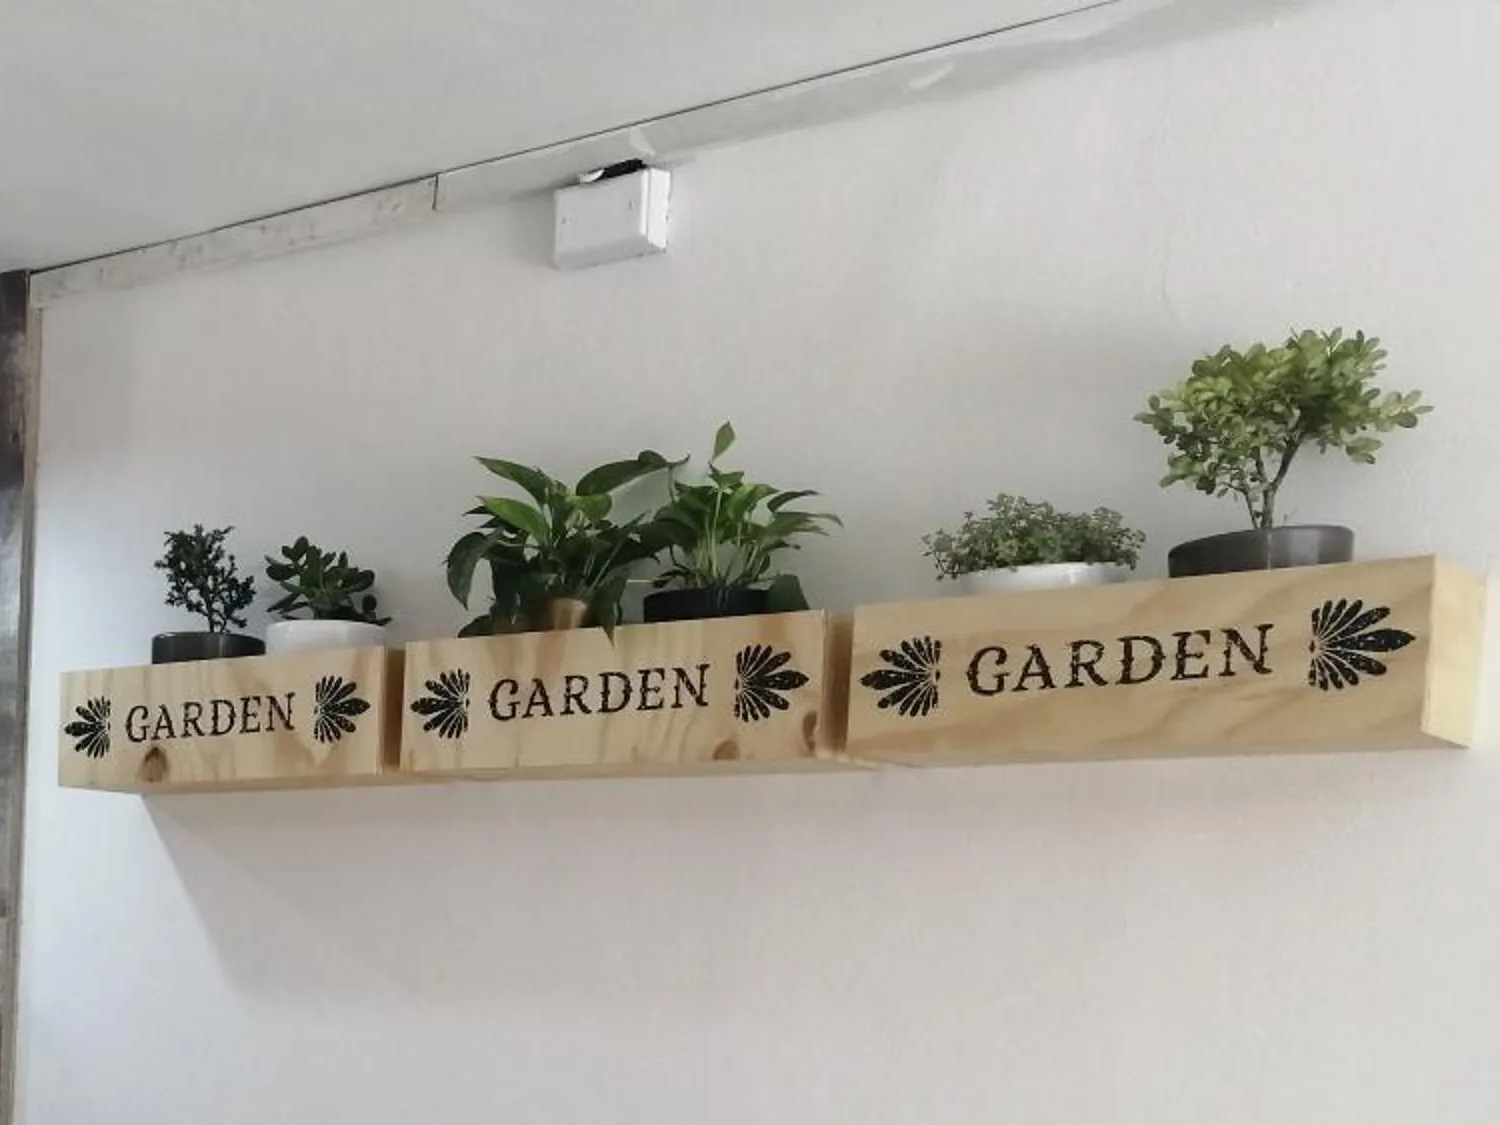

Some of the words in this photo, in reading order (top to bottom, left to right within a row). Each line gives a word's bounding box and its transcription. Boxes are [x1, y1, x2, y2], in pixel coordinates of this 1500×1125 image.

[965, 623, 1274, 697] GARDEN
[124, 691, 296, 743] GARDEN
[486, 663, 711, 722] GARDEN
